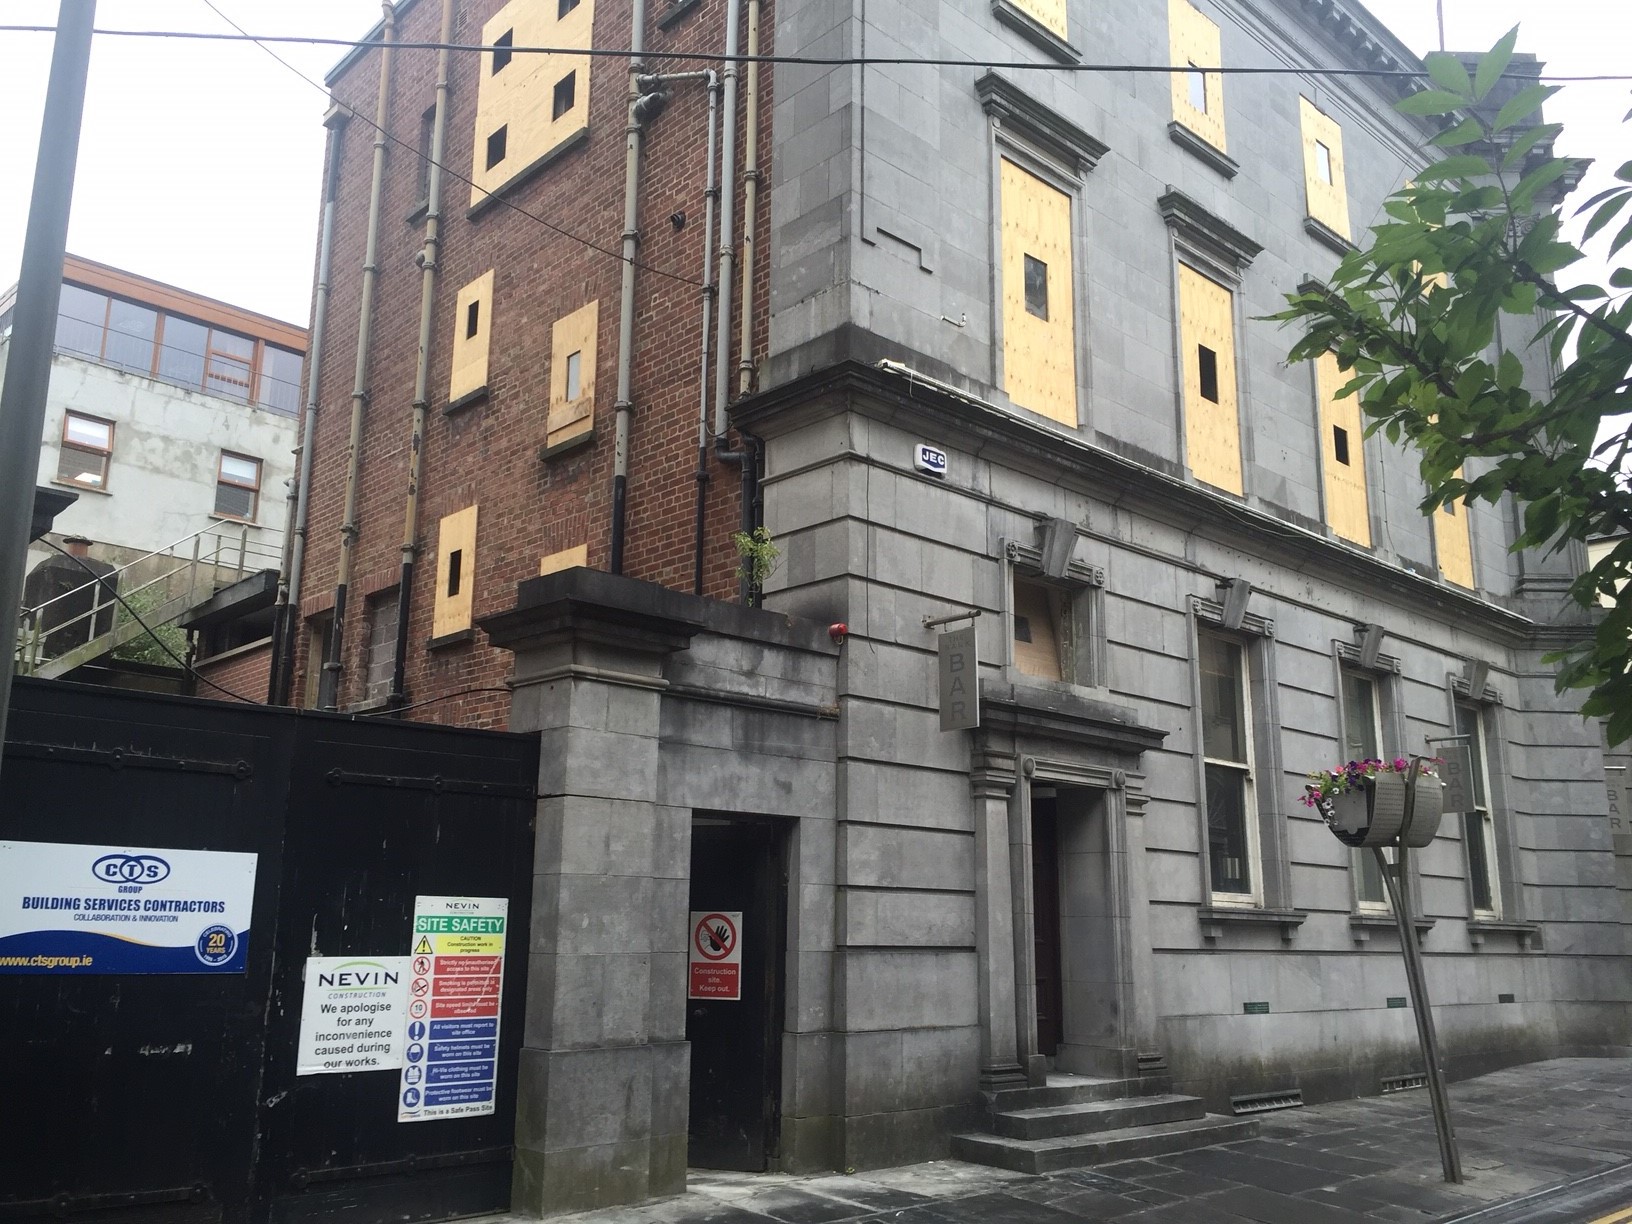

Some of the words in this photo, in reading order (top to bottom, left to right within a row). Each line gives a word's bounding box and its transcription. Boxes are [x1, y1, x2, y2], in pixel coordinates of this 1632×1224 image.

[923, 448, 945, 466] JEC
[949, 653, 968, 722] BAR
[1448, 762, 1465, 808] BAR
[1607, 789, 1621, 829] BAR
[105, 863, 159, 878] CTS
[118, 885, 143, 894] GROUP
[22, 896, 81, 911] BUILDING
[84, 898, 141, 912] SERVICES
[143, 899, 225, 913] CONTRACTORS
[73, 913, 131, 922] COLLABORATION
[139, 915, 179, 923] INNOVATION
[418, 918, 448, 931] SITE
[452, 919, 503, 932] SAFETY
[208, 933, 225, 947] 20
[694, 967, 737, 975] Construction
[318, 971, 399, 987] NEVIN
[328, 991, 386, 999] CONSTRUCTION
[699, 984, 717, 993] Keep
[320, 1003, 338, 1014] We
[340, 1002, 392, 1015] apologise
[415, 1004, 423, 1012] 10
[336, 1016, 352, 1027] for
[355, 1017, 374, 1027] any
[315, 1029, 392, 1042] inconvenience
[314, 1044, 354, 1055] caused
[357, 1043, 391, 1056] during
[323, 1059, 346, 1069] our
[346, 1056, 380, 1067] works.
[465, 1105, 480, 1113] Pass
[481, 1104, 493, 1112] Site
